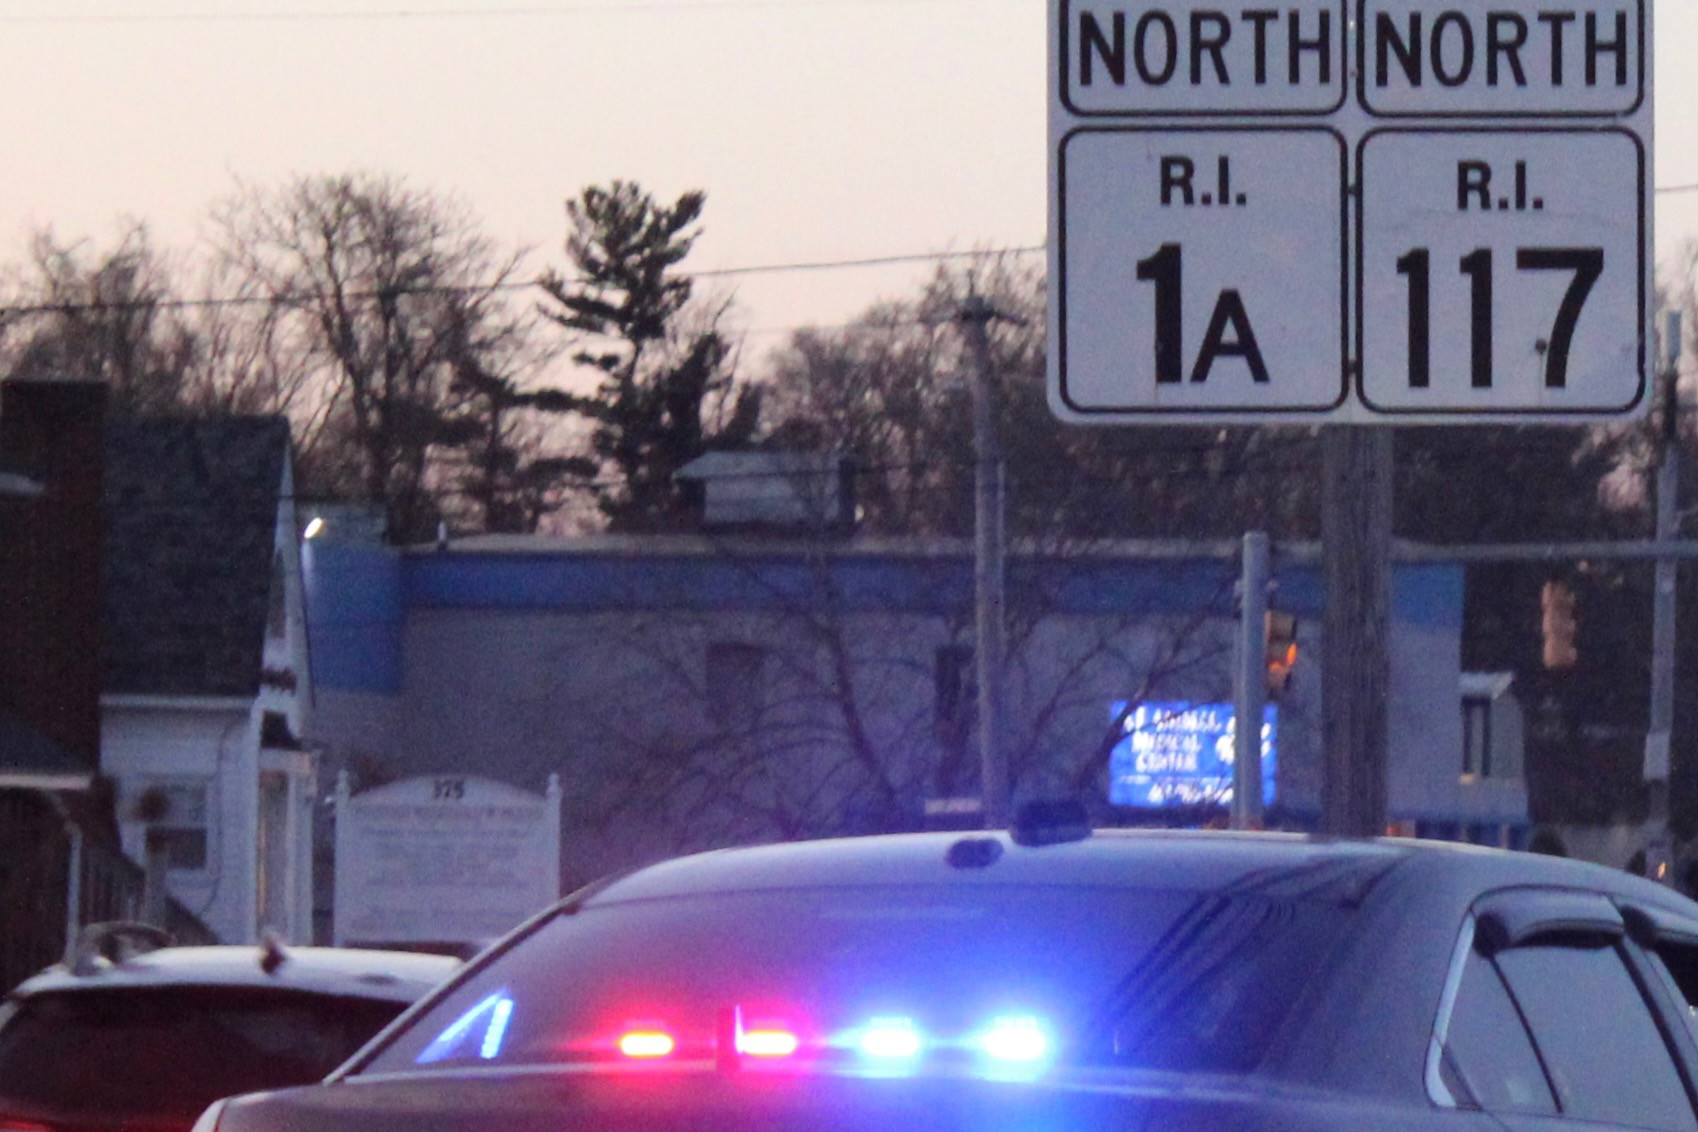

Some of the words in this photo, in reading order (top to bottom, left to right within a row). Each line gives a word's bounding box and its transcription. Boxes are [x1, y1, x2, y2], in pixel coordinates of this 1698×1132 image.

[1080, 11, 1331, 86] NORTH
[1375, 11, 1627, 87] NORTH
[1160, 155, 1246, 205] R.I.
[1456, 160, 1544, 210] R.I.
[1137, 243, 1269, 383] 1A
[1397, 247, 1604, 388] 117
